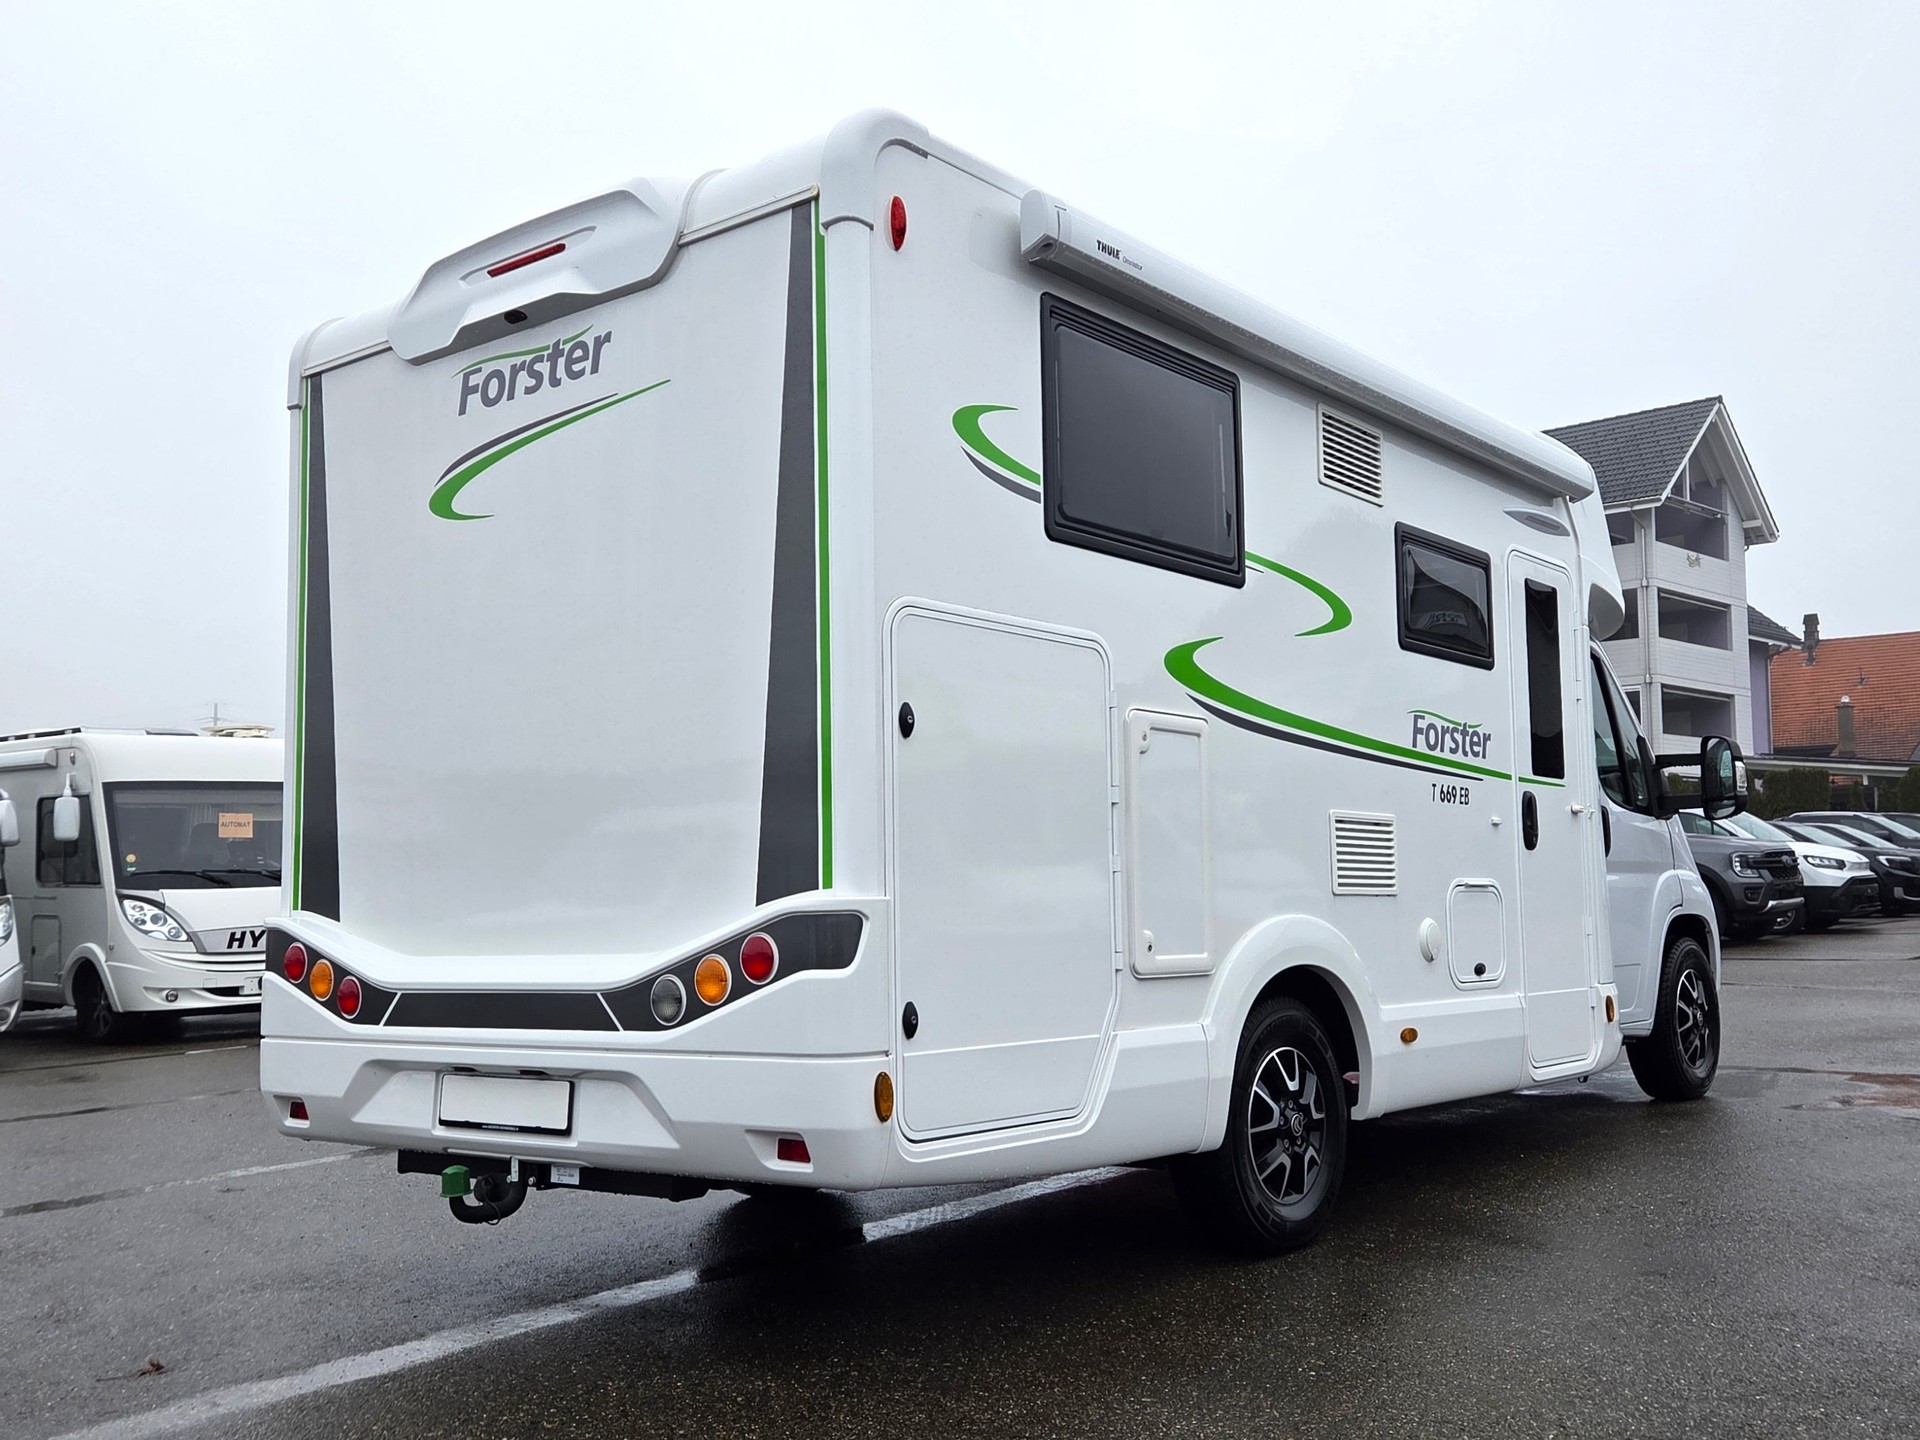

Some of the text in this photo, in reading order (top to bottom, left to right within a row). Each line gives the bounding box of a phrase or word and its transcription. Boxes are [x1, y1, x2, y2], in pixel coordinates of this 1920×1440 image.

[1096, 239, 1120, 260] THULE
[457, 329, 613, 418] Forster
[1411, 713, 1492, 760] Forster
[1431, 783, 1470, 806] T 669 EB
[220, 820, 251, 828] AUTOMAT
